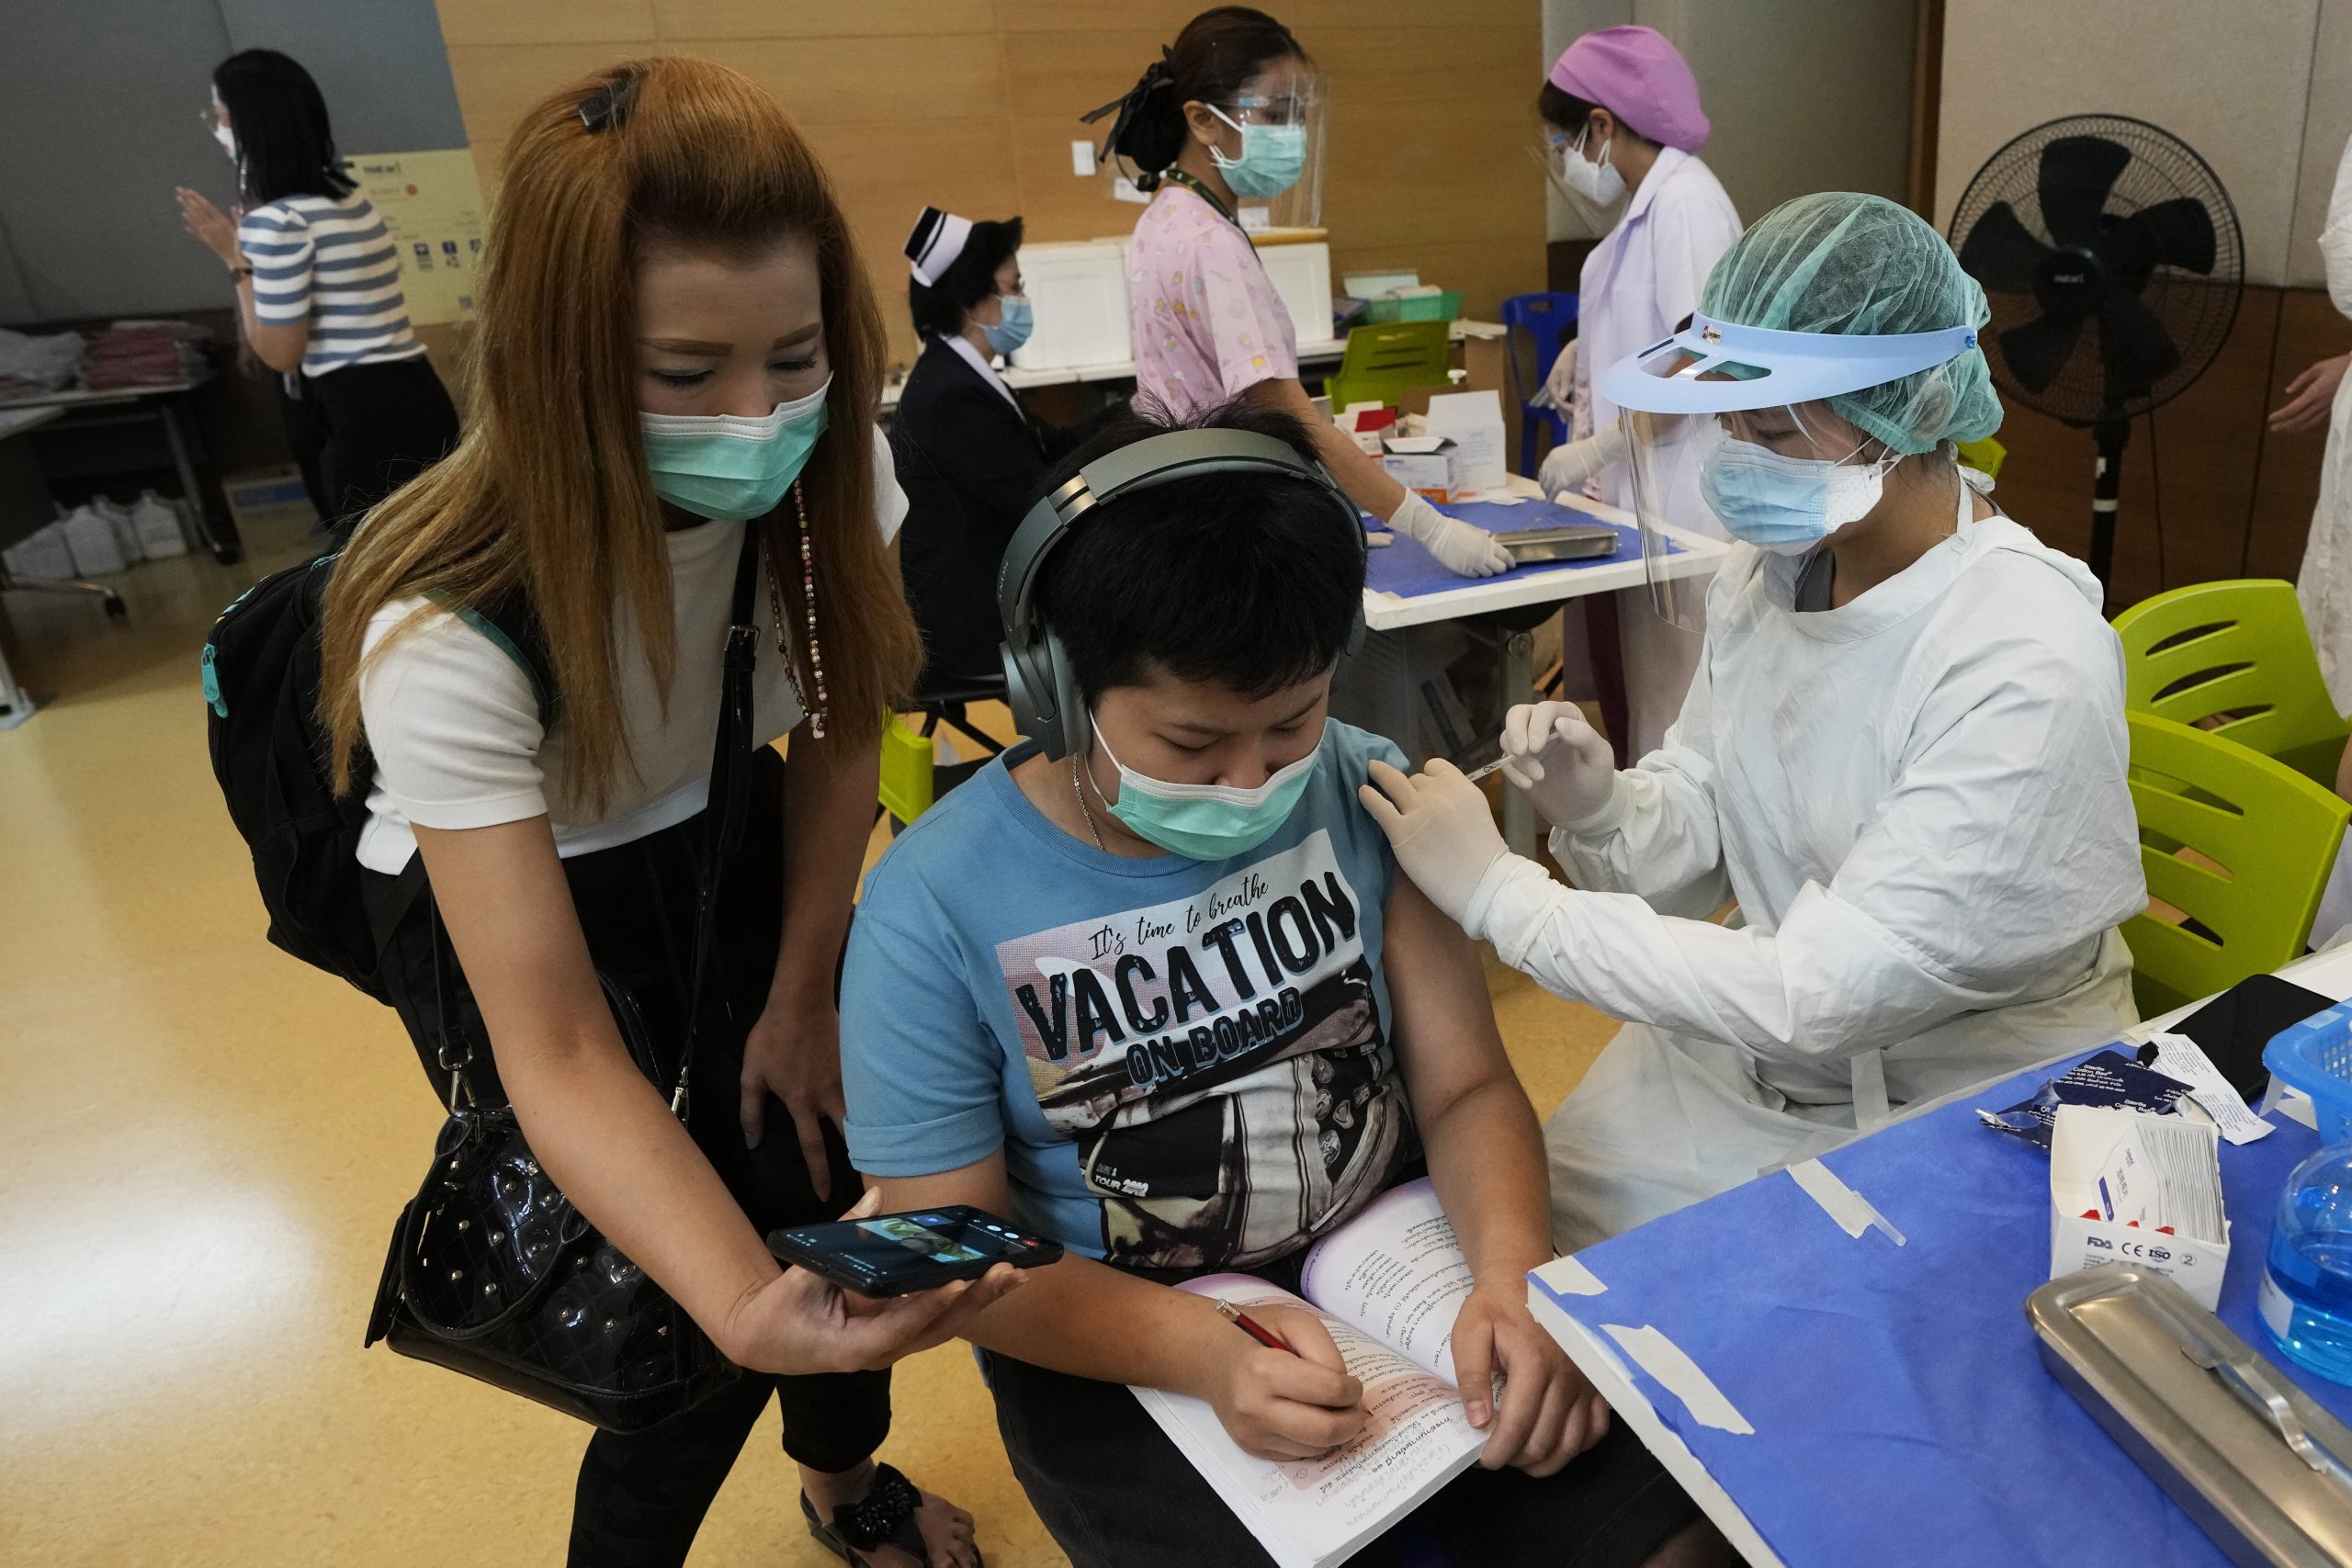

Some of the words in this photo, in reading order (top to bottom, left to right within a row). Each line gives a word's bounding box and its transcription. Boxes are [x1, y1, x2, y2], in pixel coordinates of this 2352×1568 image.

[1088, 924, 1127, 960] It's
[1136, 916, 1176, 945] time
[1185, 905, 1202, 934] to
[1209, 873, 1269, 919] breathe
[1015, 871, 1357, 1063] VACATION
[1125, 1034, 1185, 1088] ON
[1187, 986, 1304, 1067] BOARD
[1095, 1175, 1121, 1190] TOUR
[2086, 1236, 2113, 1250] FDA
[2148, 1248, 2171, 1260] ISO
